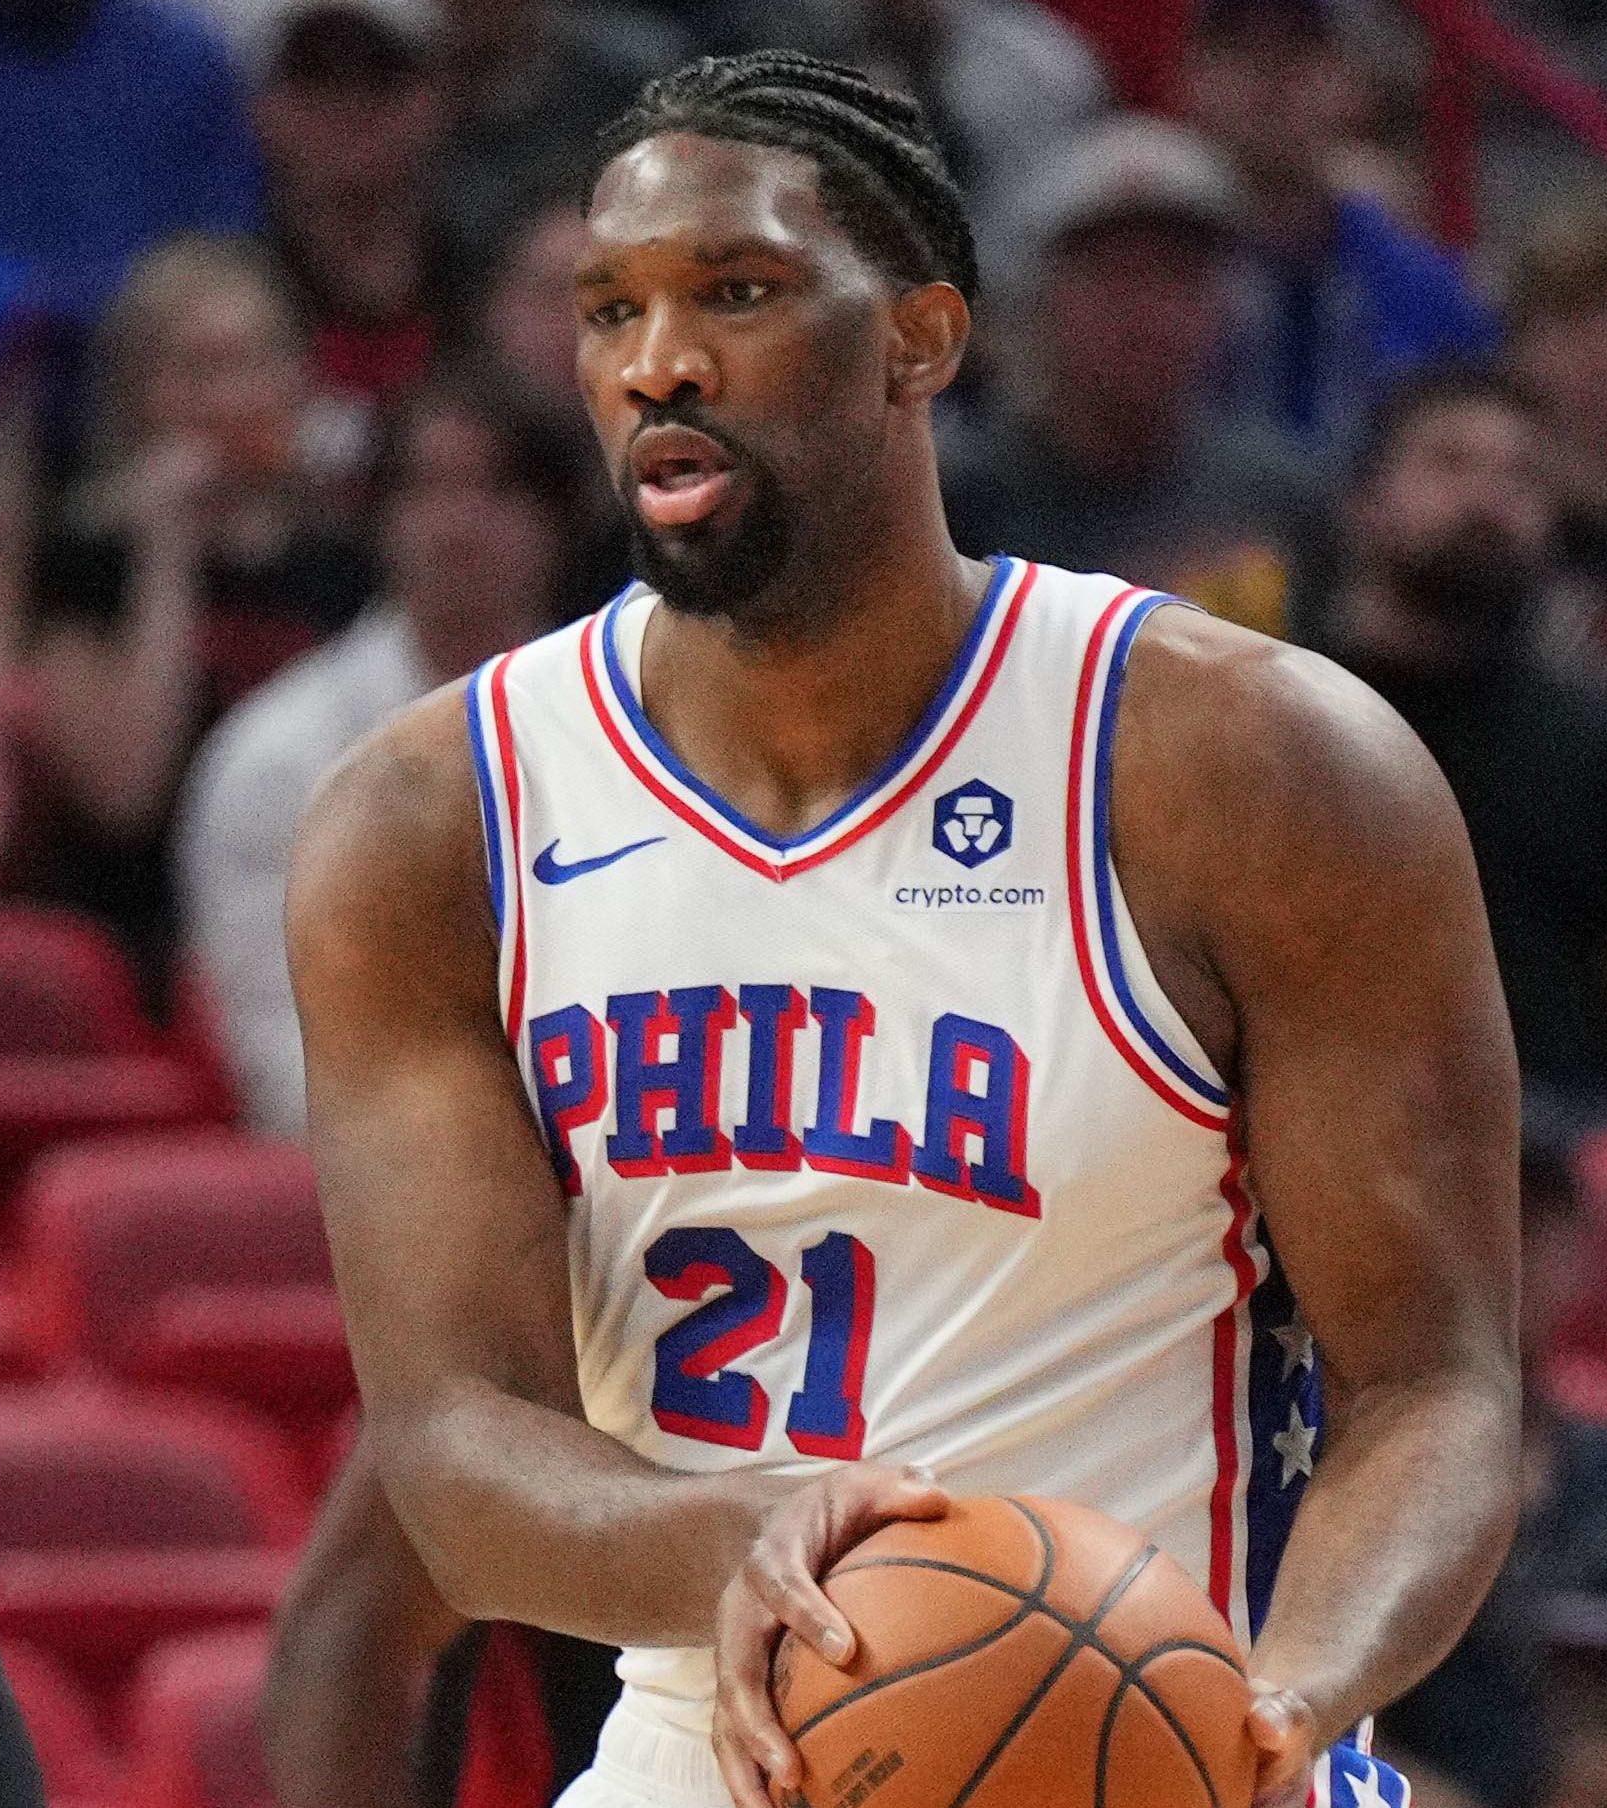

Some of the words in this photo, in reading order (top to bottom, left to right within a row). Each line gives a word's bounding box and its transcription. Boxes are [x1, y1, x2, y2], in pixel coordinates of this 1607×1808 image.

[895, 882, 1044, 909] crypto.com
[528, 984, 1042, 1219] PHILA
[644, 1226, 875, 1462] 21
